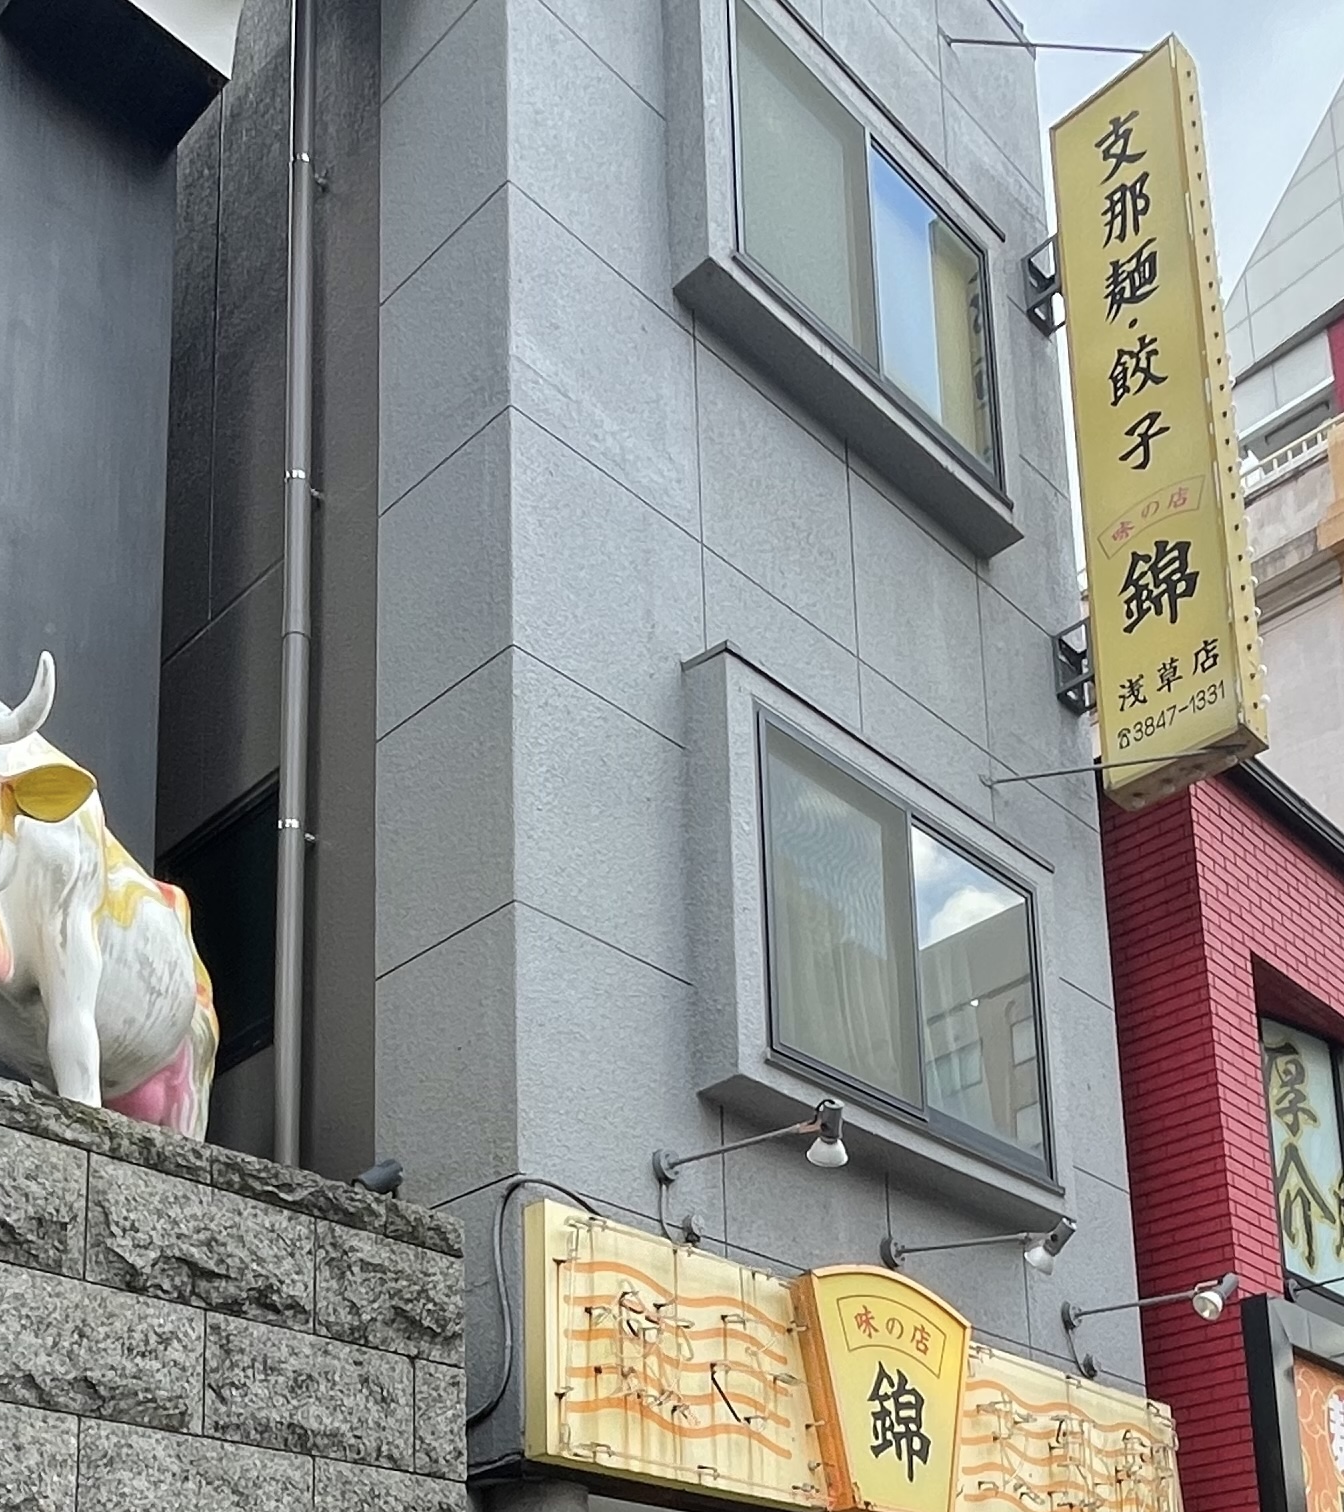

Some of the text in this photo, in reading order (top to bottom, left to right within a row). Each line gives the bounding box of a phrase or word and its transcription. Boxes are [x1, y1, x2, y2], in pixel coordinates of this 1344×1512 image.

[1111, 490, 1191, 546] 味の店
[1120, 537, 1200, 635] 錦
[1118, 637, 1222, 714] 浅草店
[854, 1304, 933, 1358] 味の店
[869, 1360, 933, 1484] 錦
